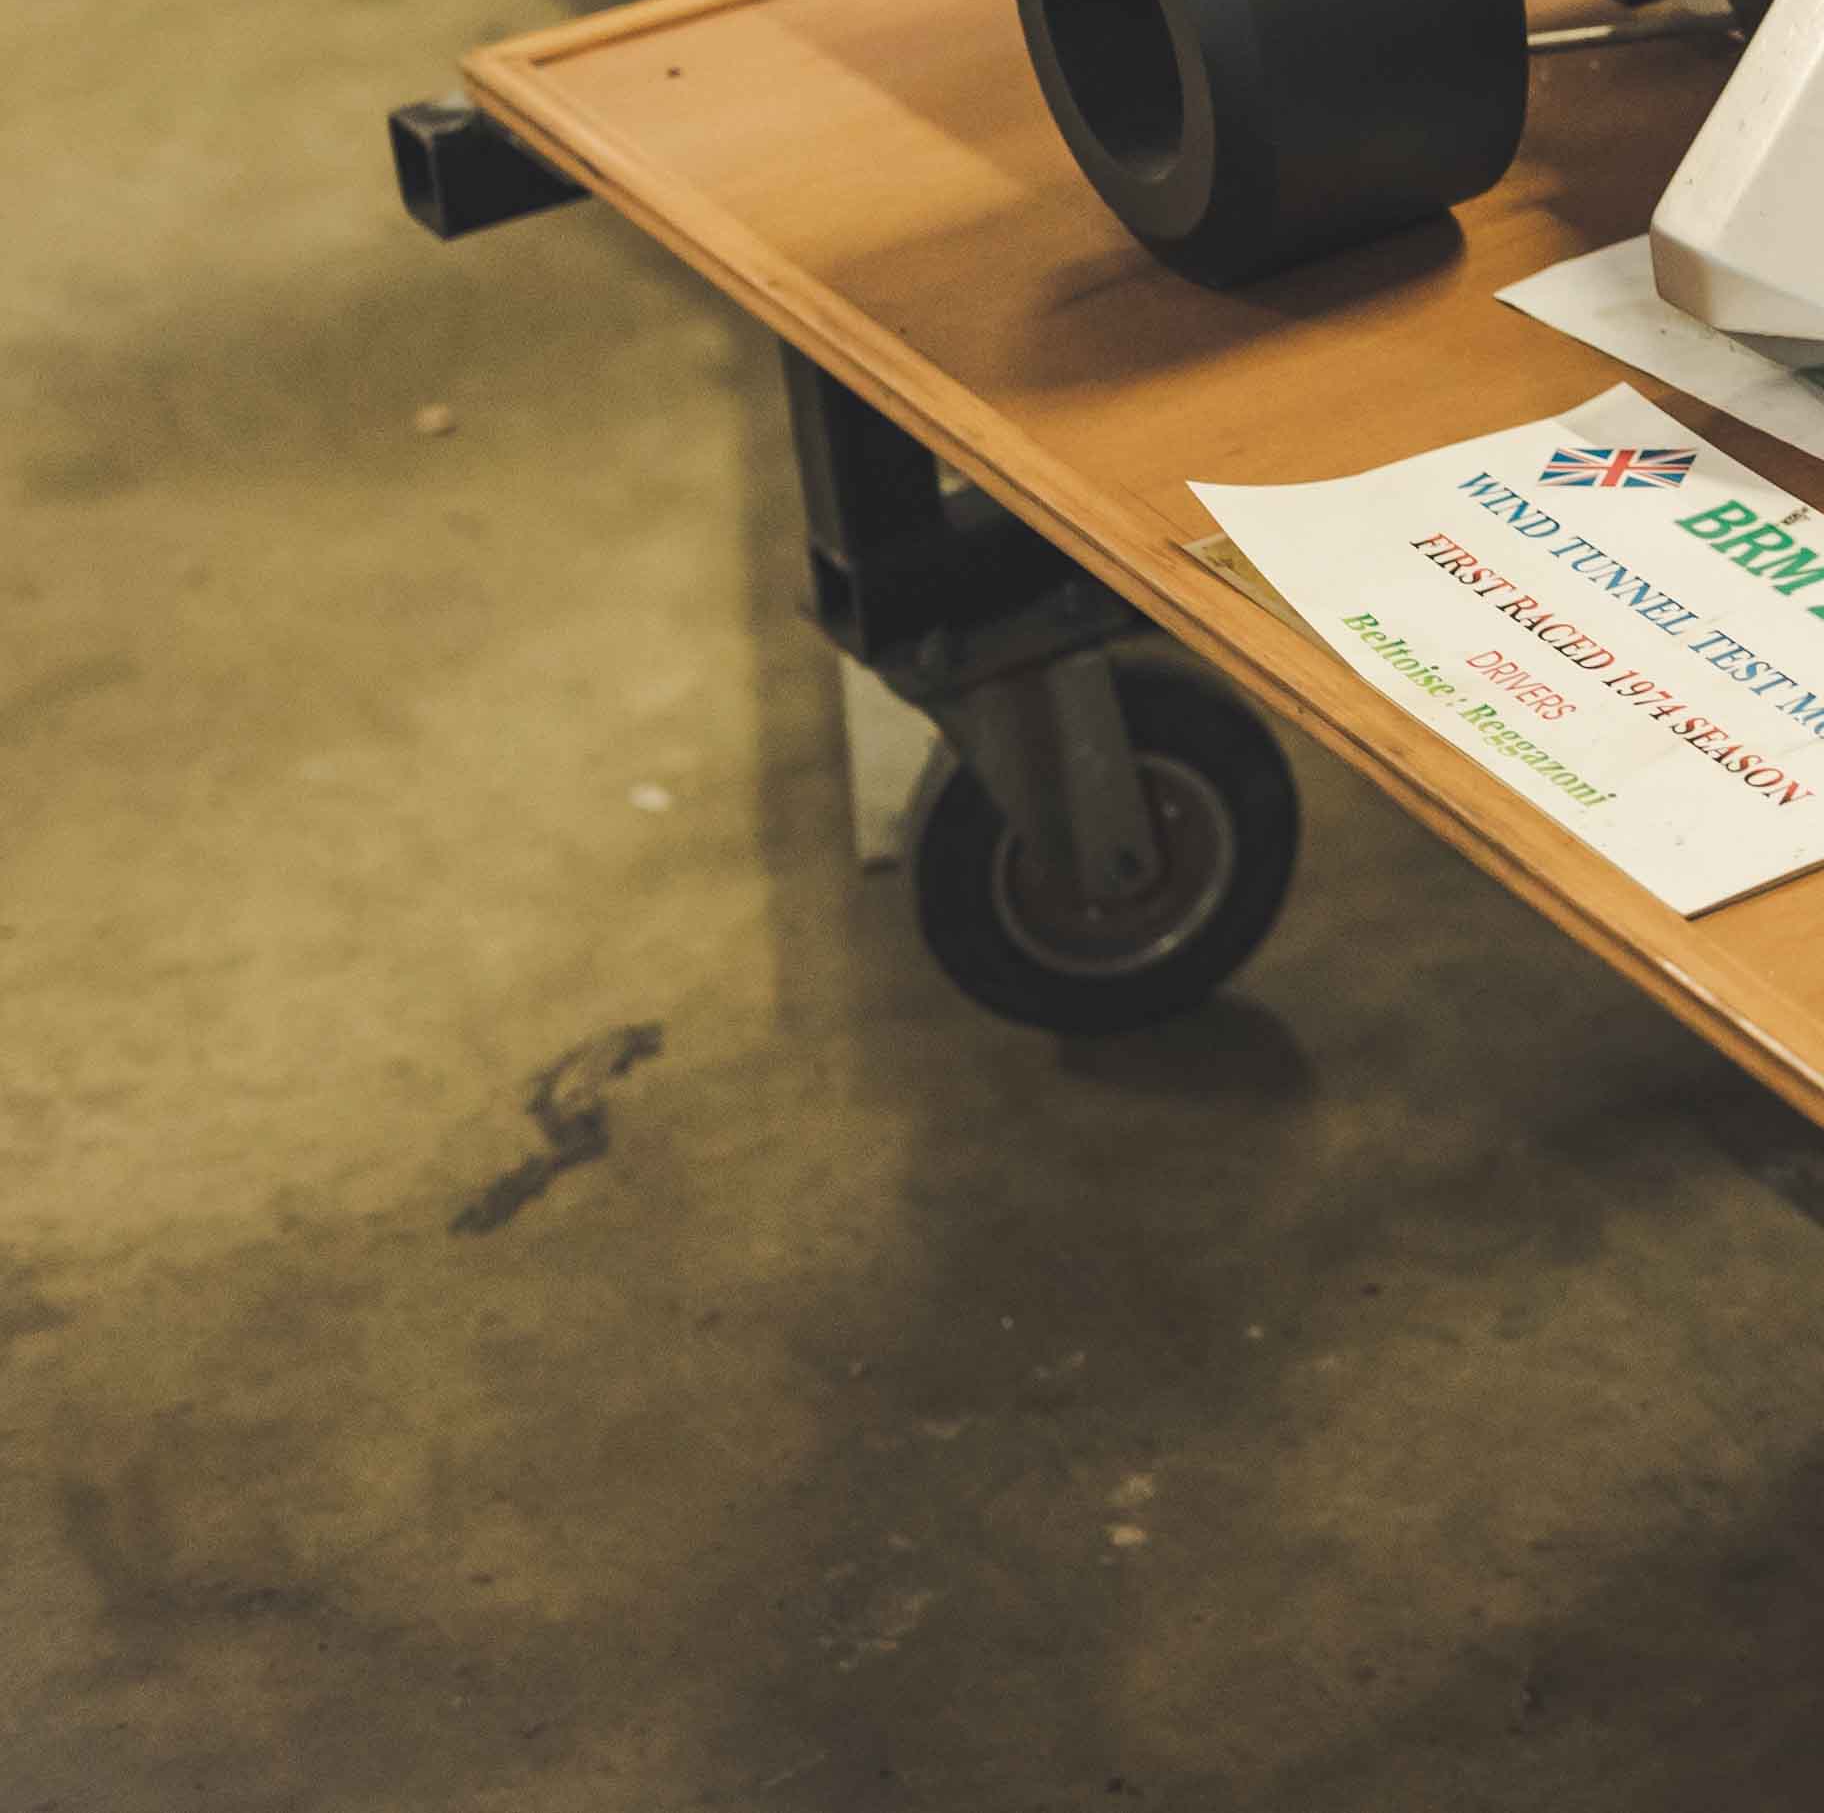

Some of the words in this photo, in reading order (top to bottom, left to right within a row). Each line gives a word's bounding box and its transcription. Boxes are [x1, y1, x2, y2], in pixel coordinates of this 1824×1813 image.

[1410, 533, 1516, 597] FIRST
[1496, 595, 1615, 670] RACED
[1602, 669, 1686, 720] 1974
[1672, 717, 1815, 806] SEASON
[1457, 471, 1560, 538] WIND
[1548, 536, 1699, 636] TUNNEL
[1688, 629, 1798, 696] TEST
[1466, 650, 1577, 721] DRIVERS
[1343, 611, 1456, 698] Beltoise
[1458, 703, 1617, 808] Reggazoni
